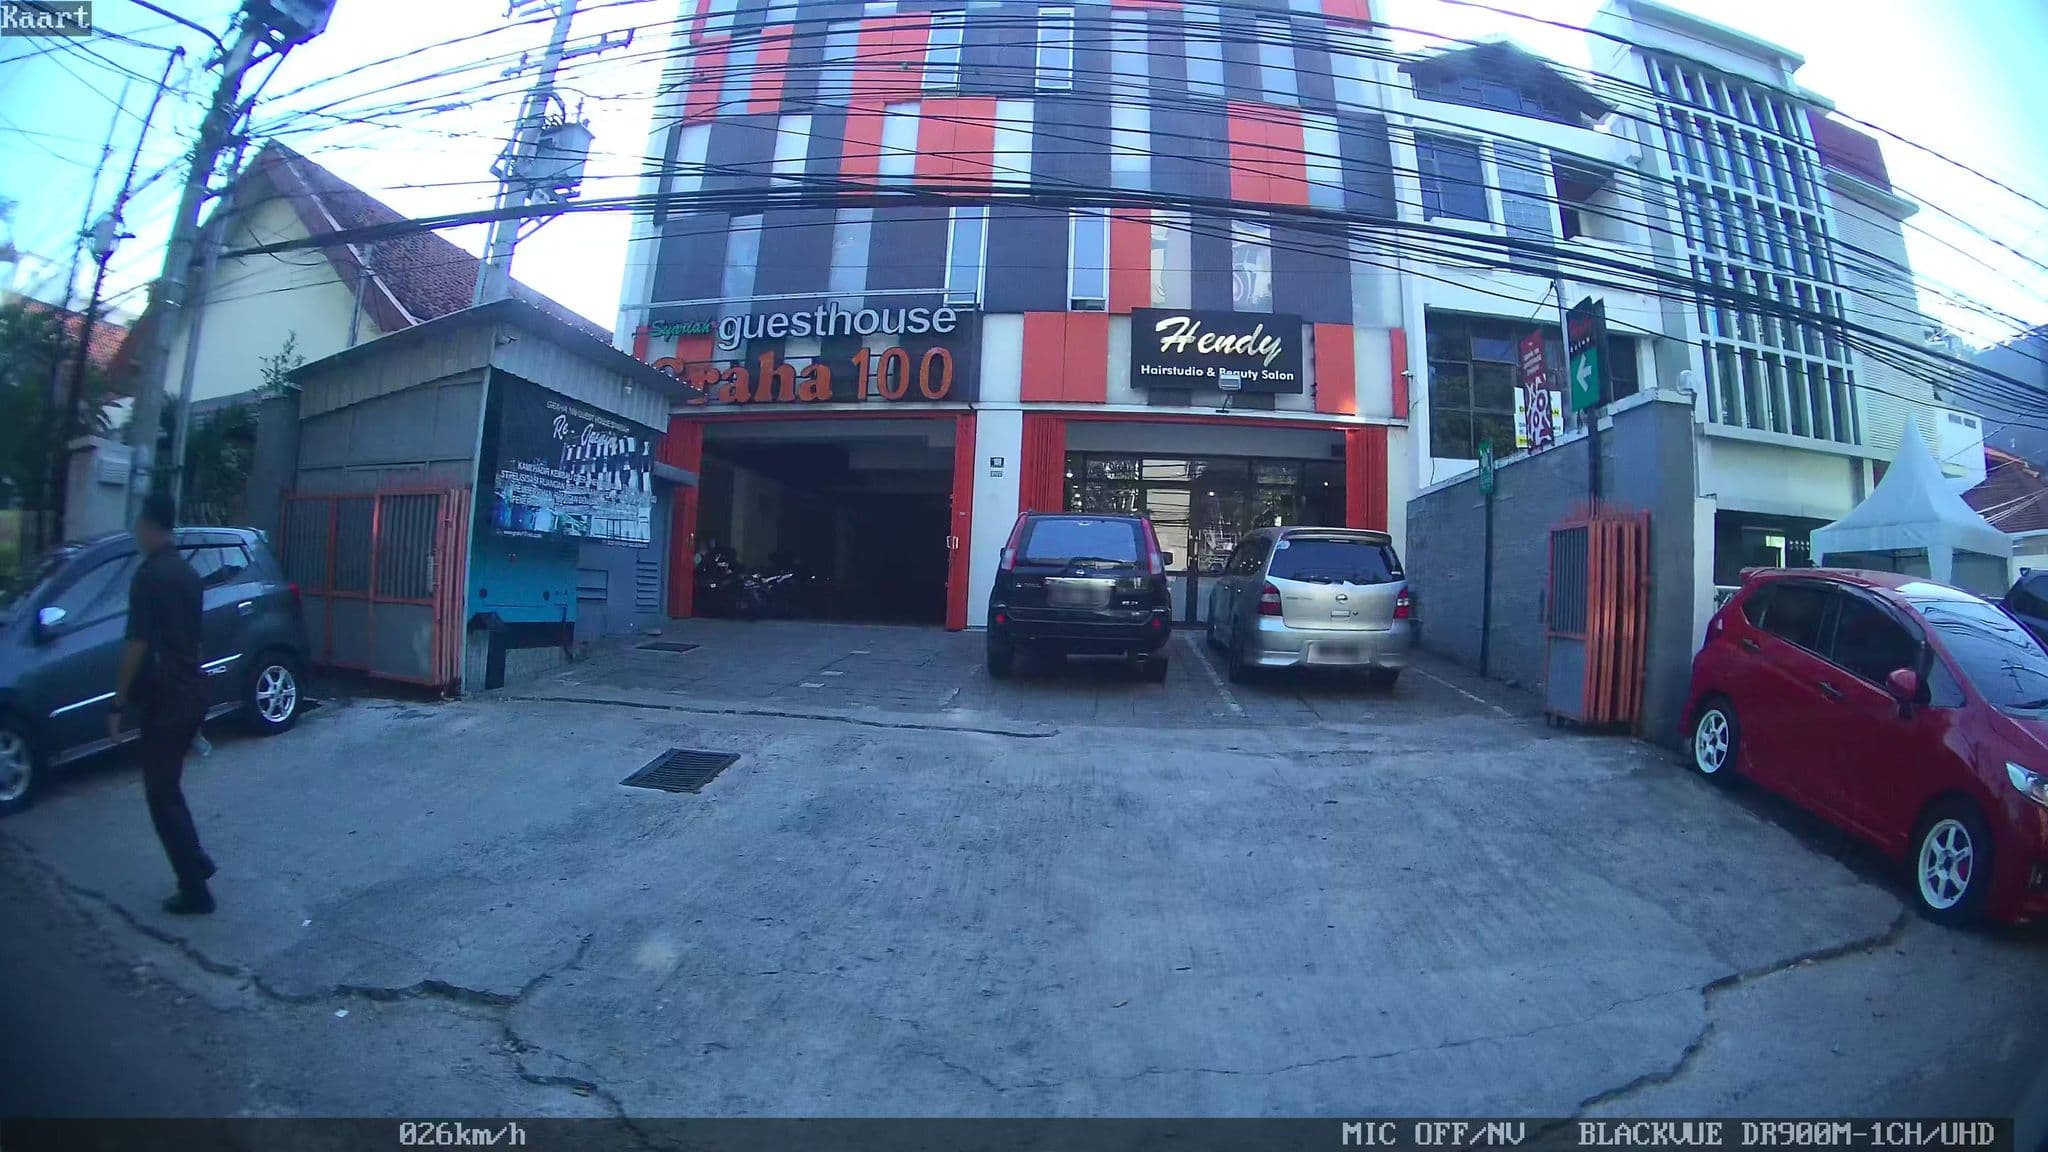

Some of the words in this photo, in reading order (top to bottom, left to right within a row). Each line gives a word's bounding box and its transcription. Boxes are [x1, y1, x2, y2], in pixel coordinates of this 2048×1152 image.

[718, 302, 957, 350] guesthouse
[1155, 316, 1282, 367] Hendy
[851, 346, 954, 402] 100
[1141, 364, 1204, 377] Hairstudio
[1206, 367, 1216, 378] &
[1261, 369, 1294, 381] Salon
